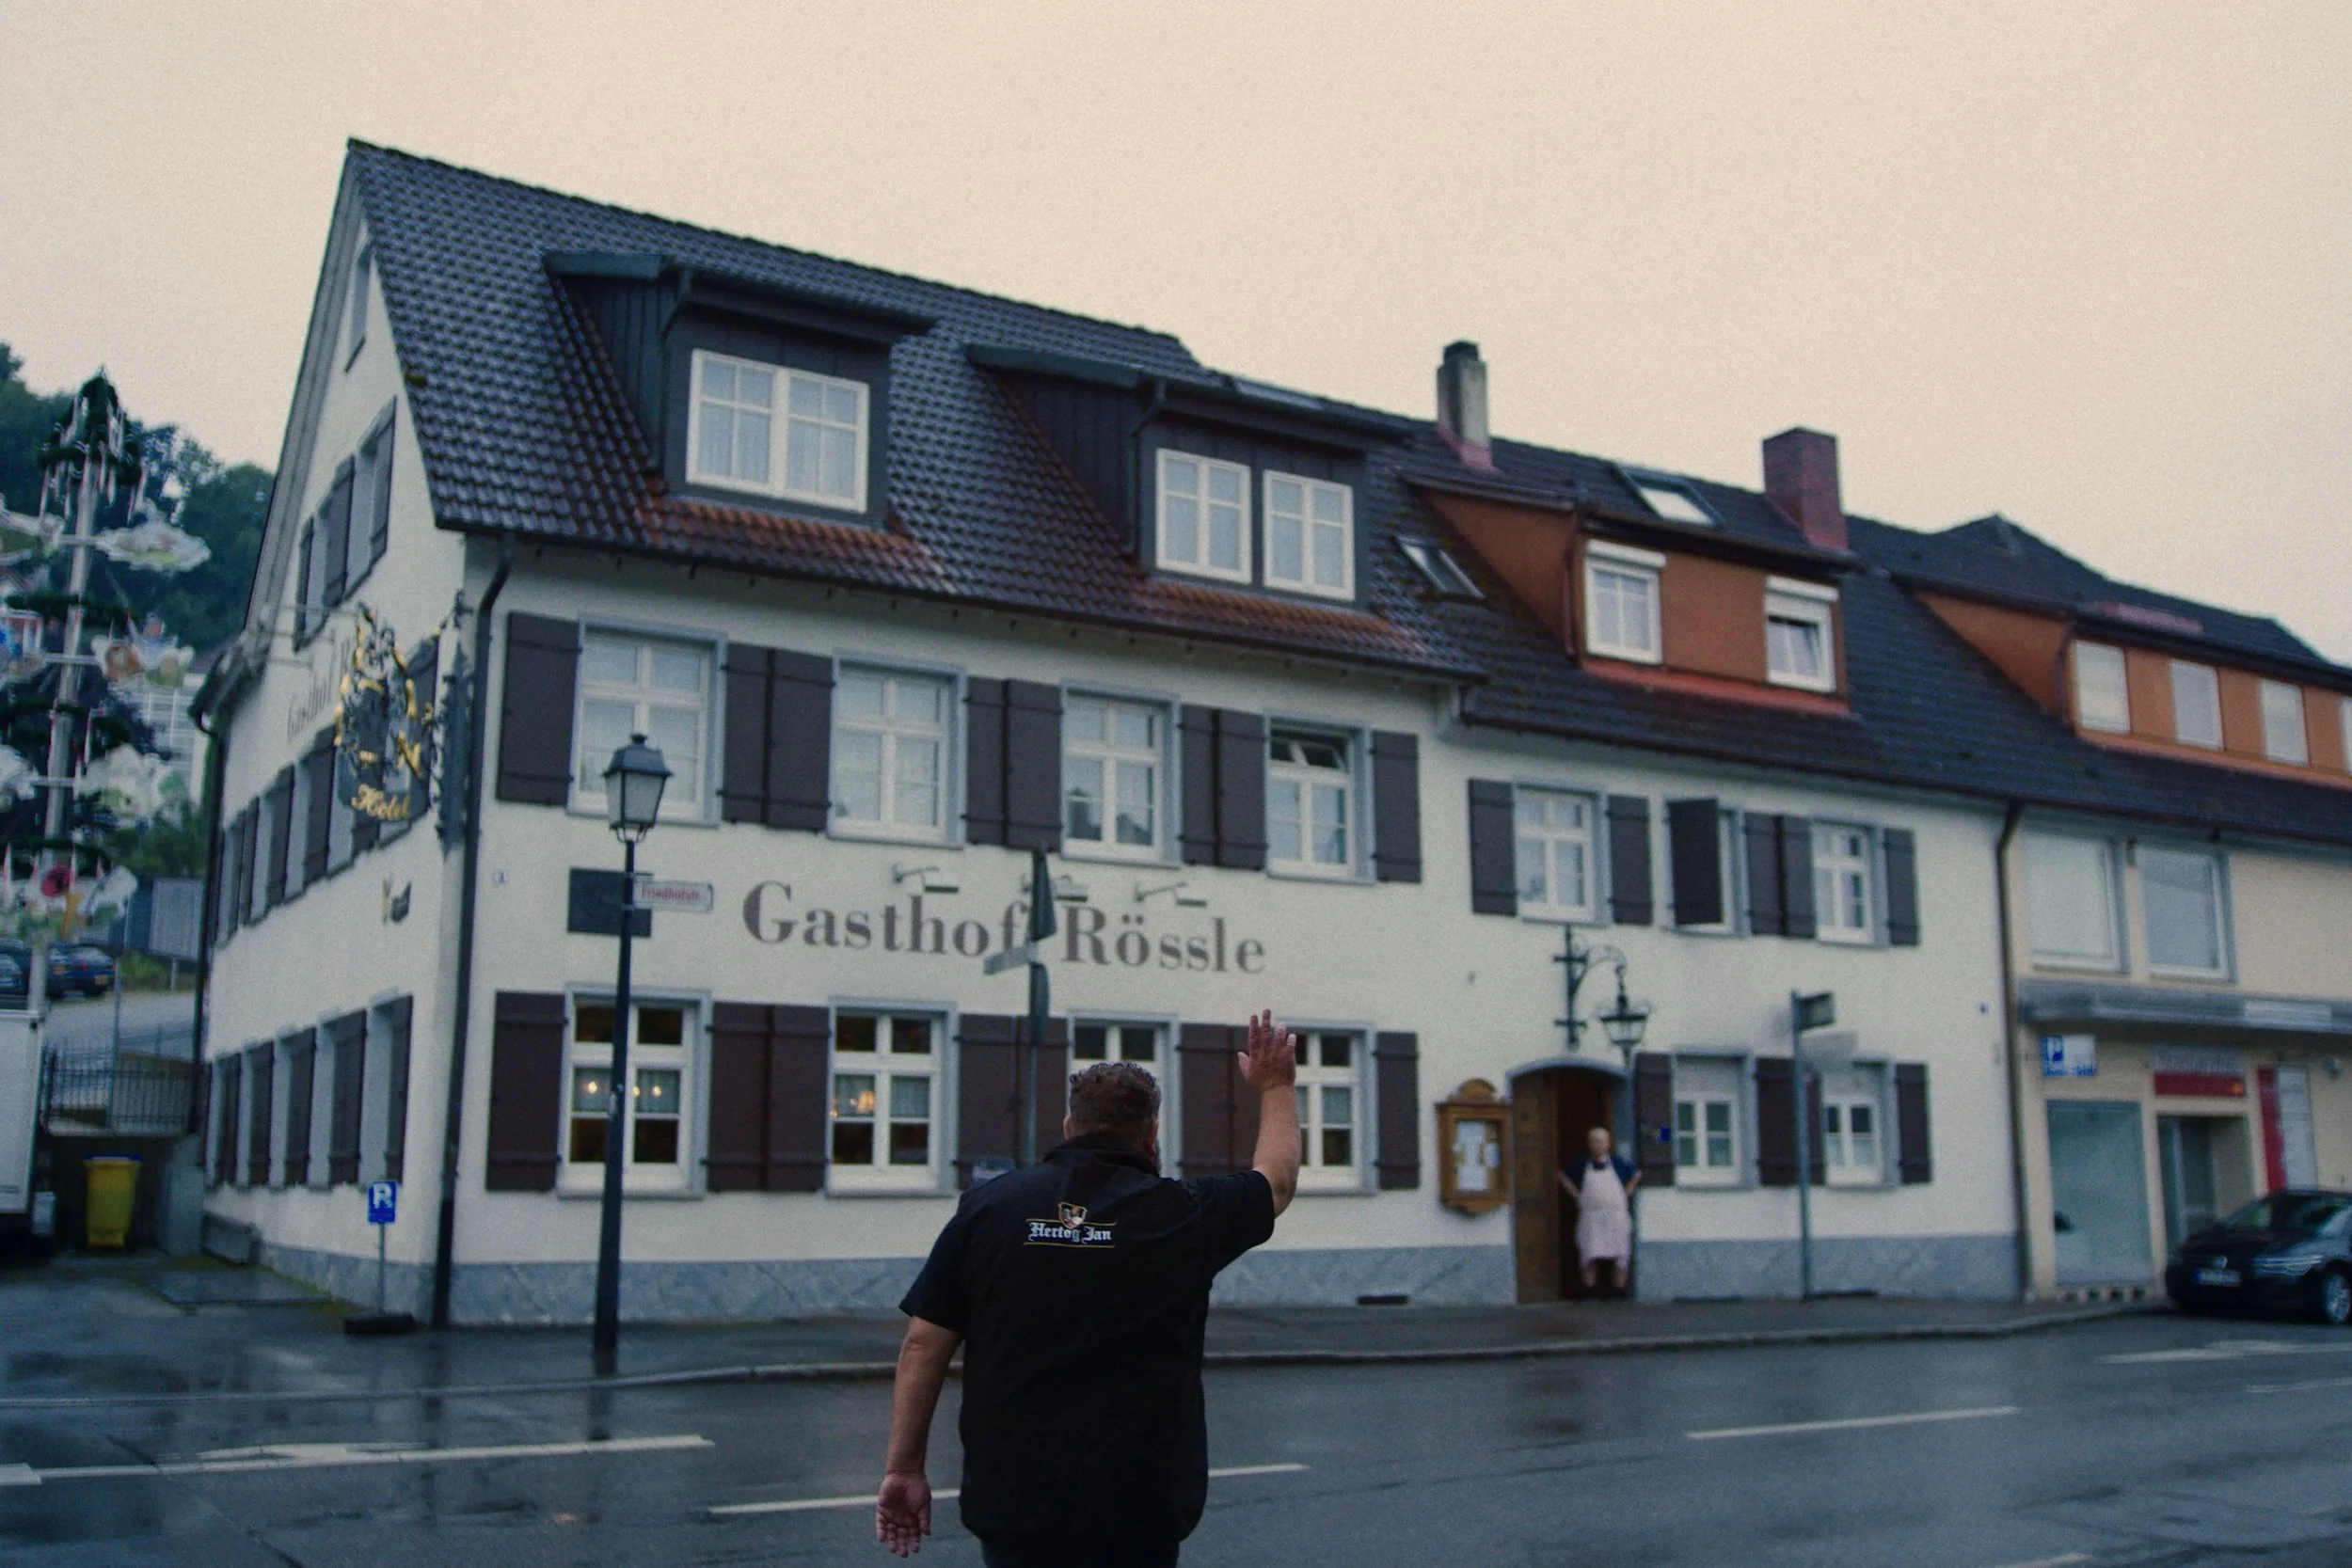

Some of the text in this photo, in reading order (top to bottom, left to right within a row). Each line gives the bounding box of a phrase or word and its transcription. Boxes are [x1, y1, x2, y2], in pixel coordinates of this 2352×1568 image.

[351, 784, 411, 820] Hotel
[742, 880, 1266, 974] Gasthof Rössle
[1028, 1222, 1112, 1244] Hertog Jan
